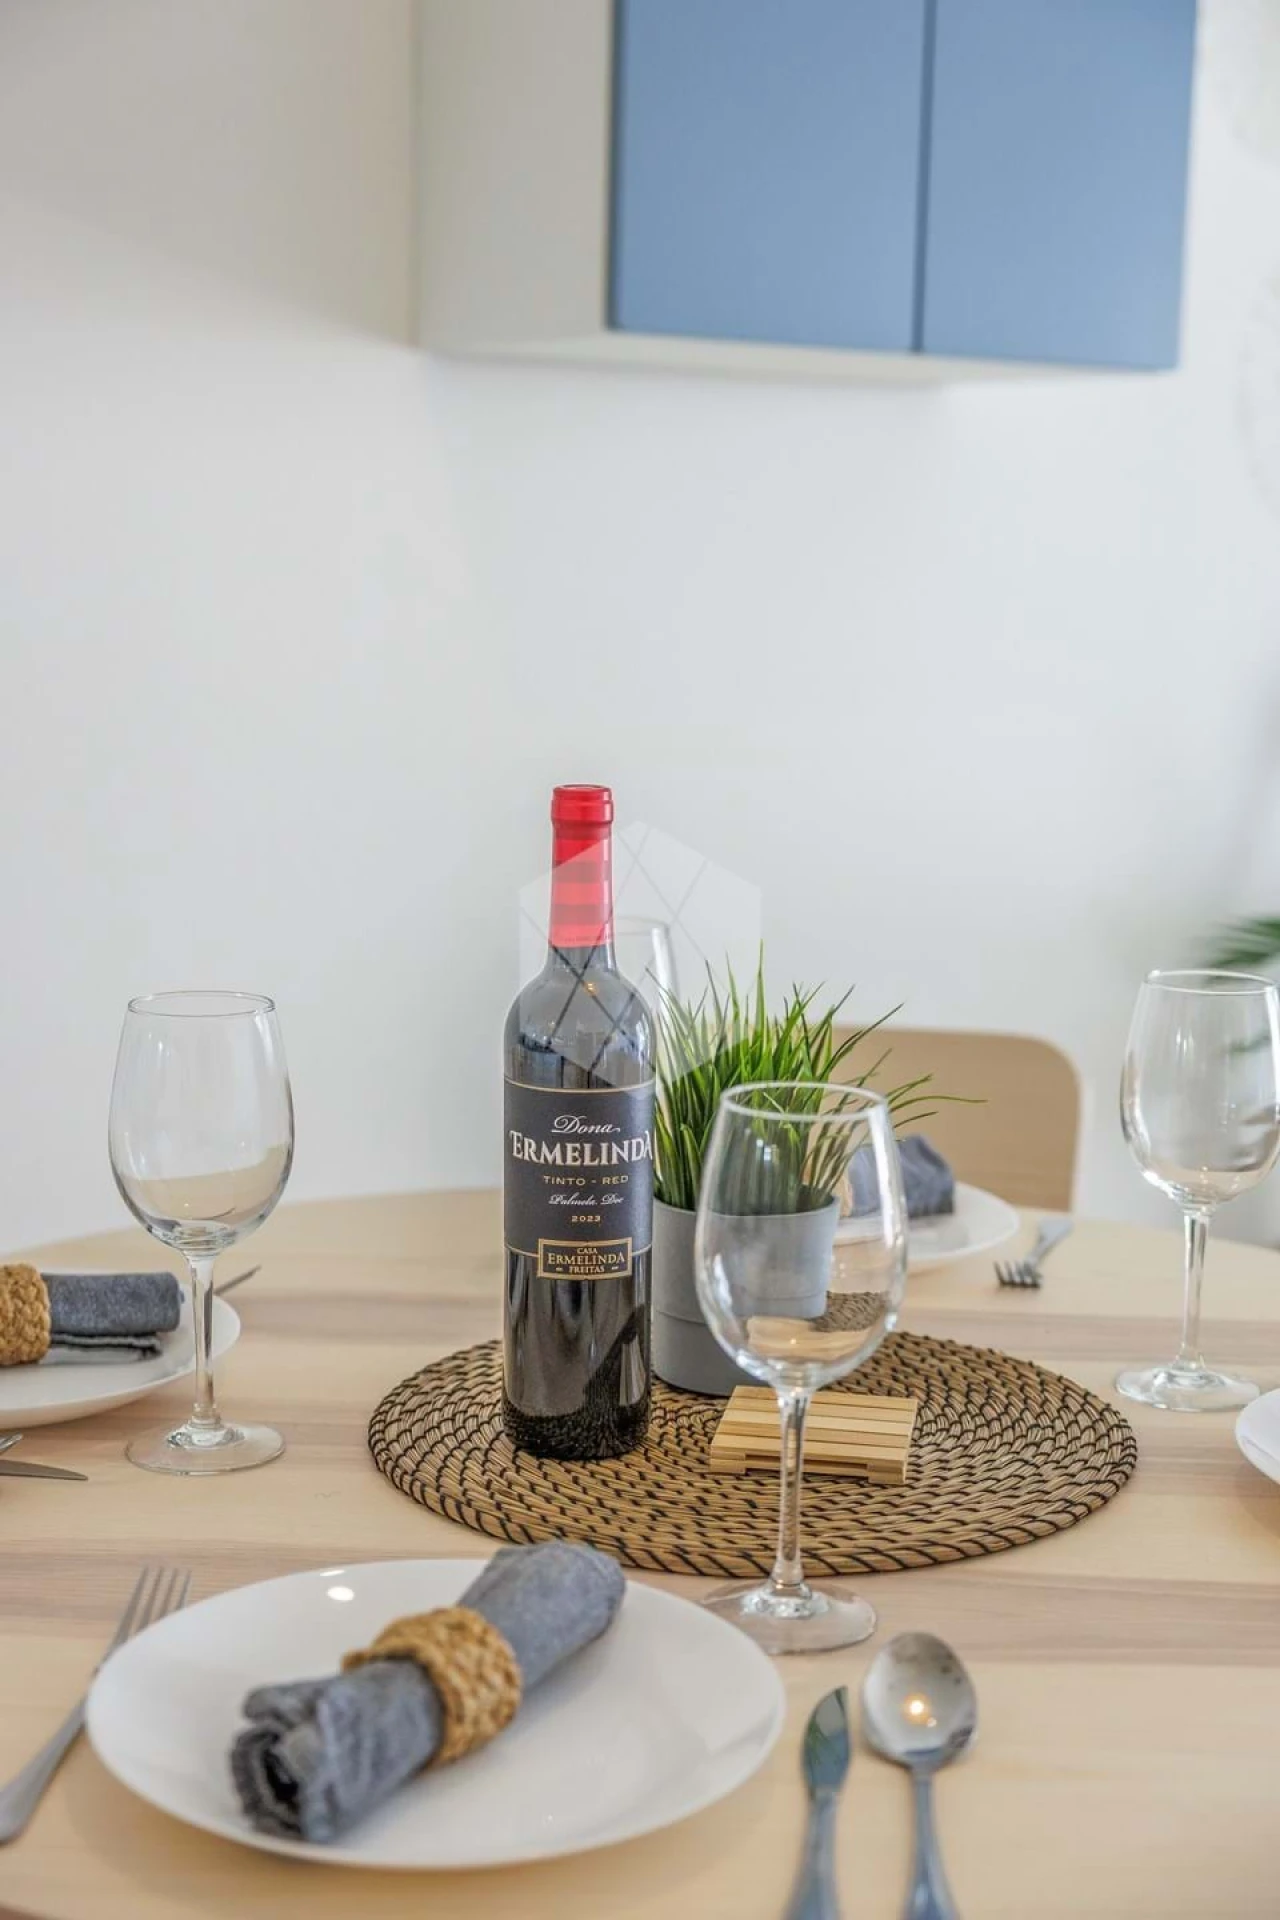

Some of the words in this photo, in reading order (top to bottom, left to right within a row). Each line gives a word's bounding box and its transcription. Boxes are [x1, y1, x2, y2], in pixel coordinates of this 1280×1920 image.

[551, 1114, 621, 1134] Dona
[509, 1130, 653, 1166] ERMELINDA
[543, 1175, 586, 1186] TINTO
[602, 1175, 629, 1185] RED
[577, 1247, 598, 1255] CASA
[548, 1252, 625, 1265] ERMELINDA
[569, 1265, 605, 1274] FREITAS
